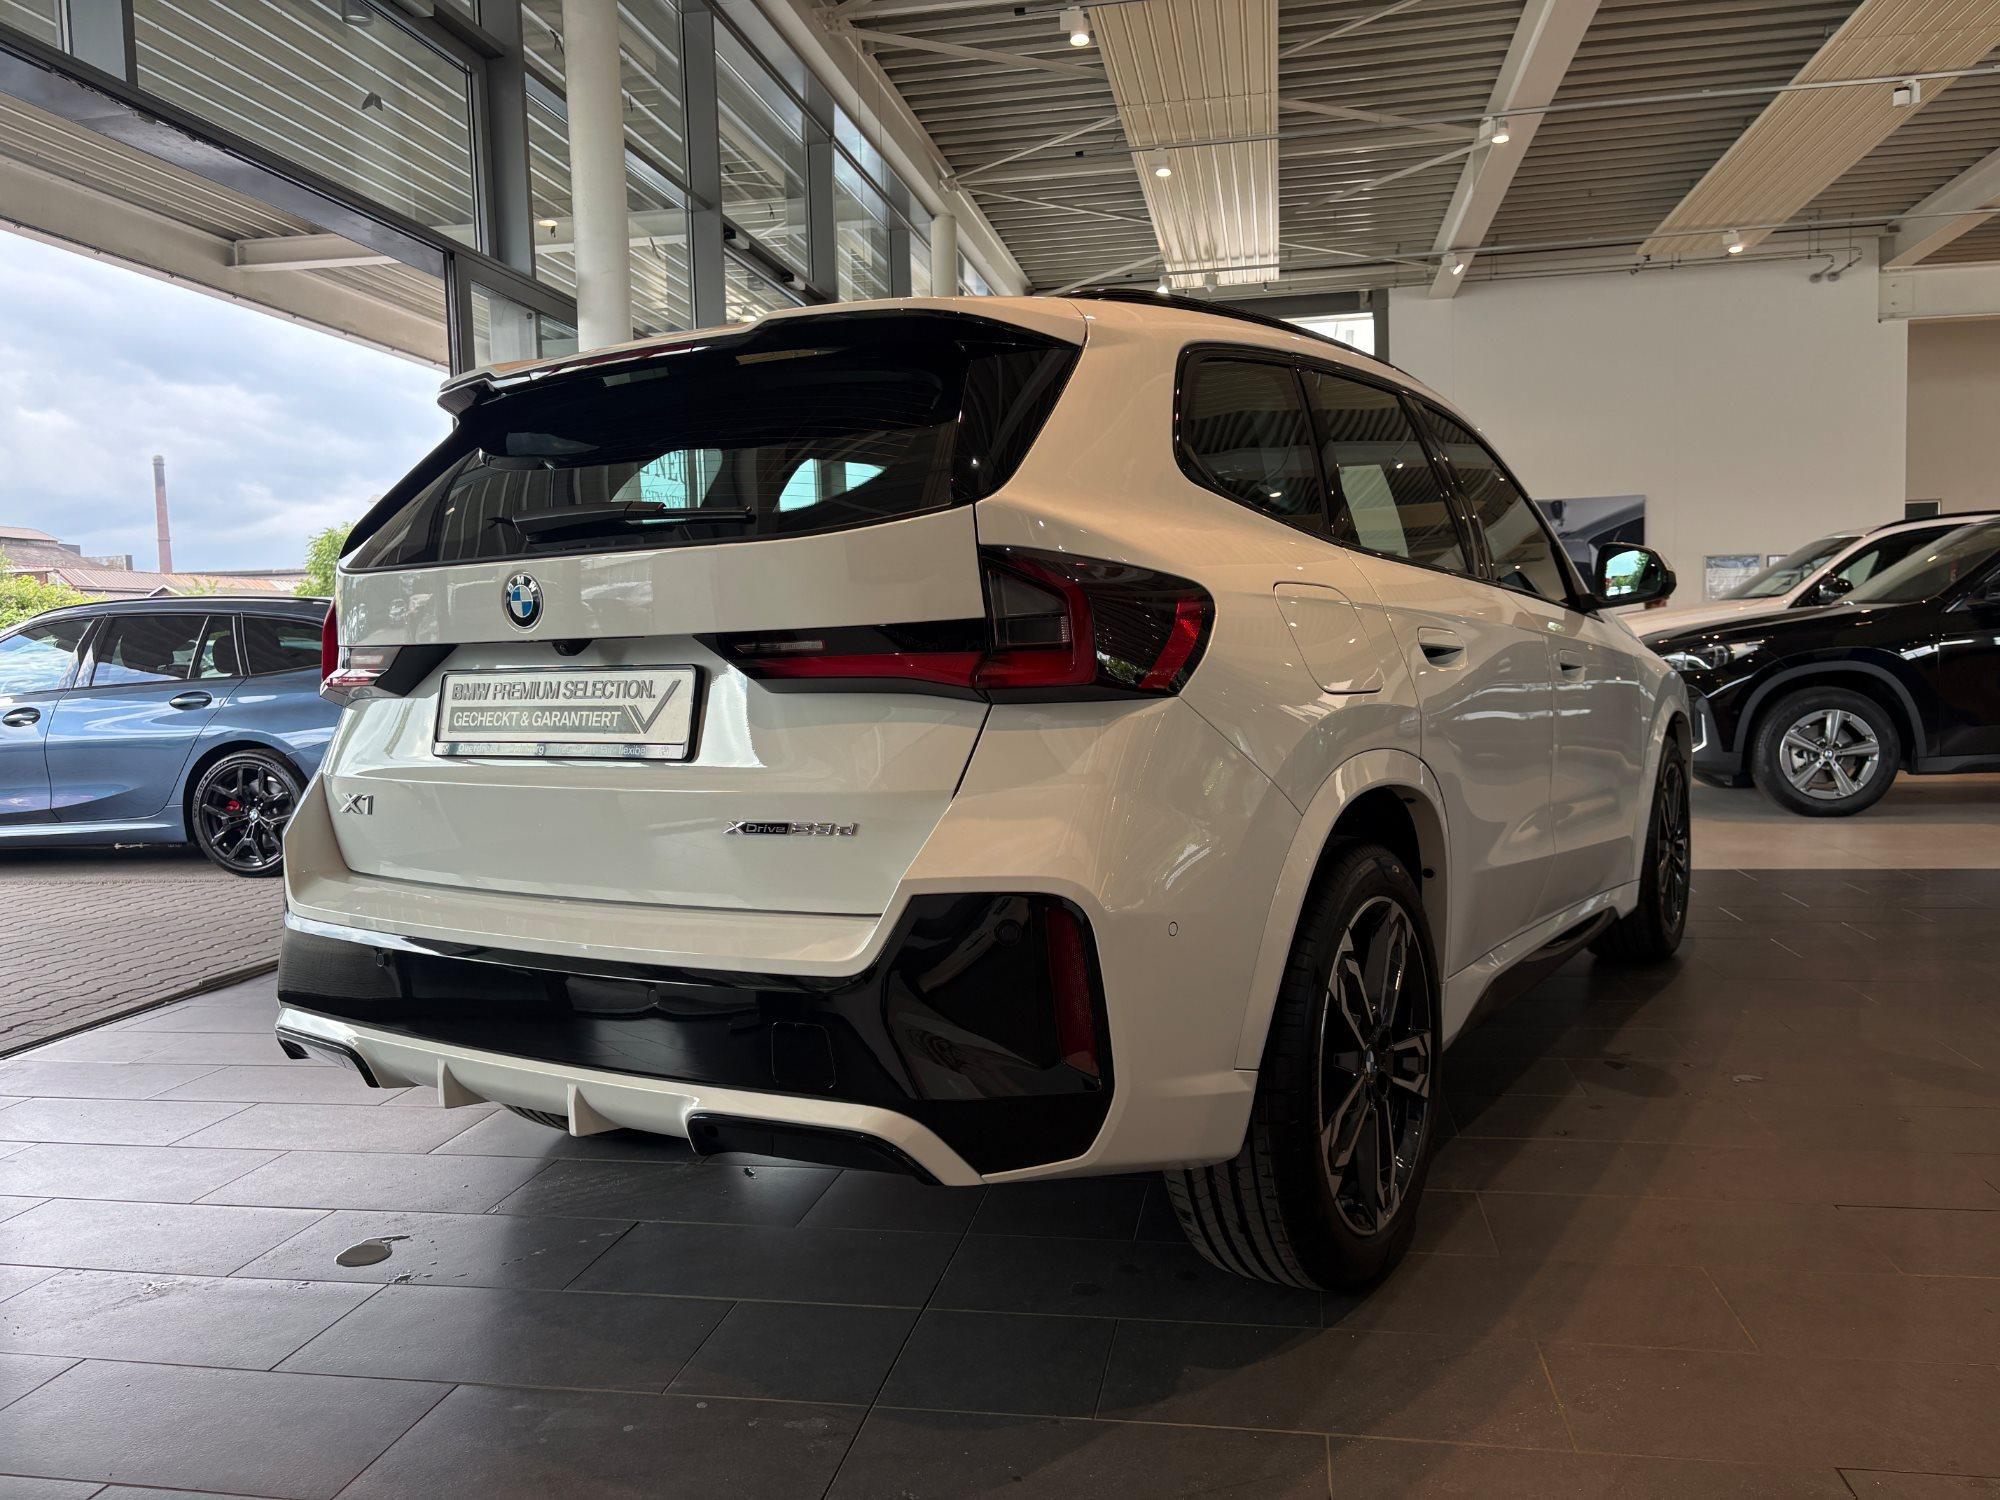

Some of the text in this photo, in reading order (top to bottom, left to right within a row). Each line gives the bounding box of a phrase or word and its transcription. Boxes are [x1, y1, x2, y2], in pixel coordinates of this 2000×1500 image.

[507, 575, 538, 593] BMW
[452, 682, 491, 700] BMW
[493, 681, 561, 700] PREMIUM
[453, 711, 621, 727] GECHECKT & GARANTIERT
[340, 793, 374, 815] X1
